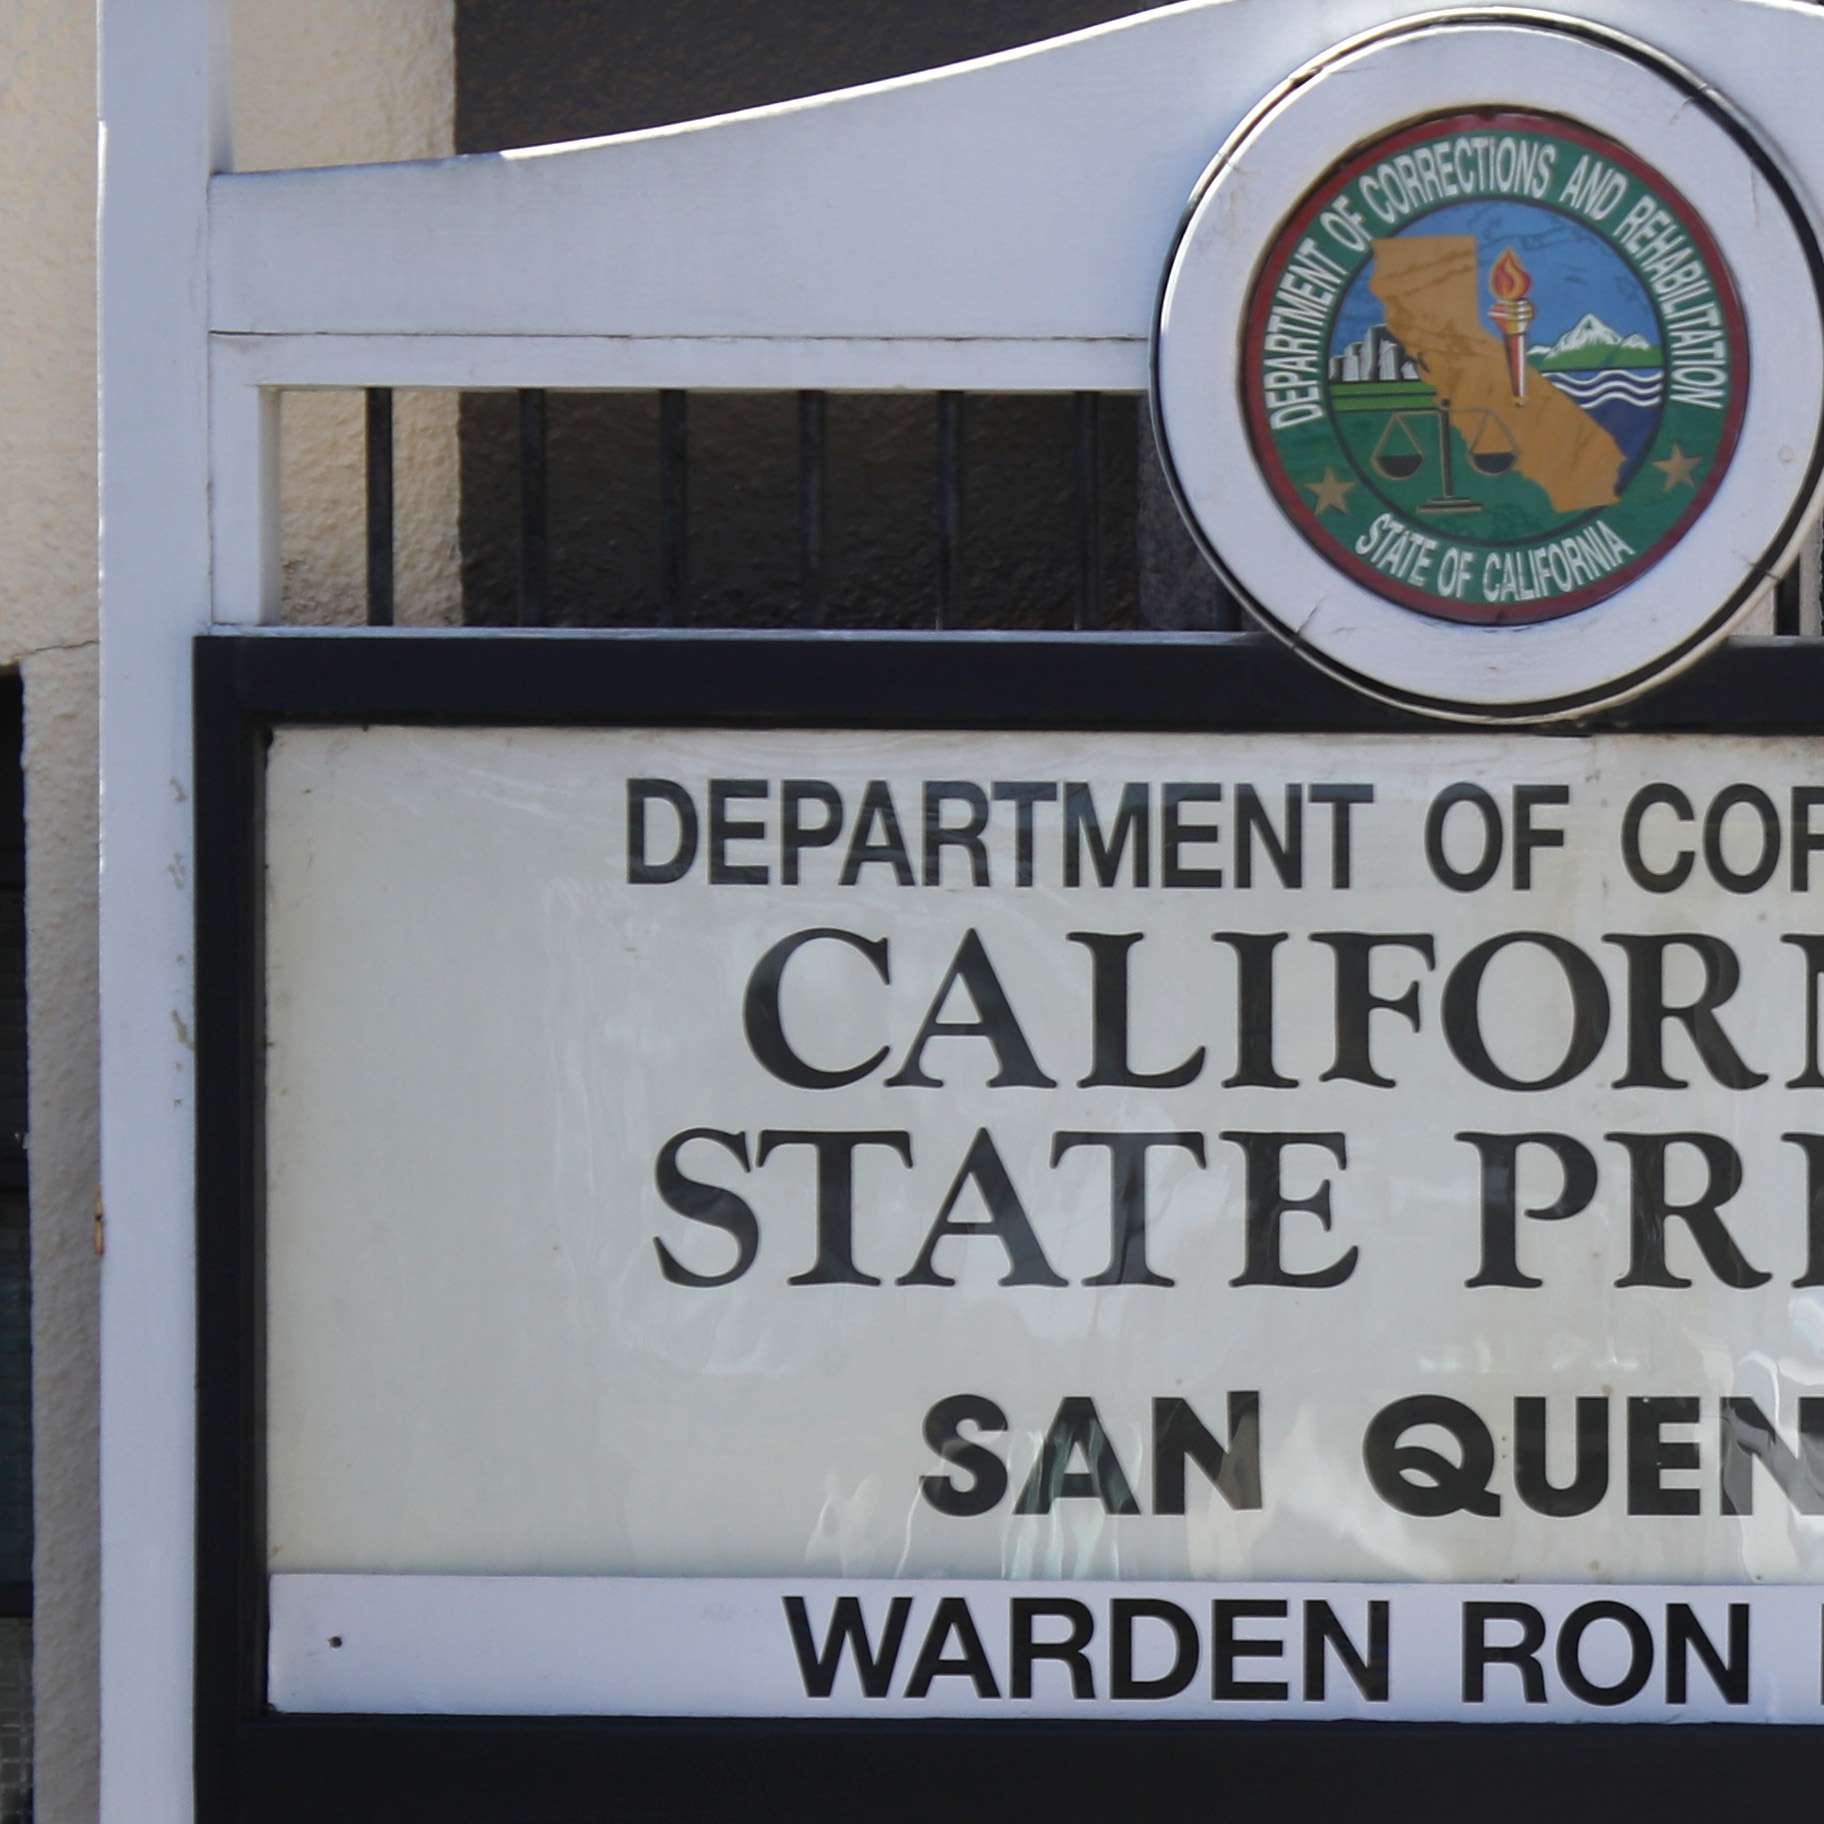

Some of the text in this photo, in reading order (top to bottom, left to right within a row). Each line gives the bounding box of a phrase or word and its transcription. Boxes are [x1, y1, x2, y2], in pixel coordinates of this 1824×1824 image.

[1263, 136, 1728, 429] DEPARTMENT OF CORRECTIONS AND REHABILITATION
[1355, 513, 1636, 602] STATE OF CALIFORNIA
[627, 778, 1374, 889] DEPARTMENT
[1425, 782, 1570, 893] OF
[653, 1127, 1359, 1288] STATE
[919, 1390, 1262, 1517] SAN
[783, 1596, 1389, 1702] WARDEN
[1462, 1600, 1749, 1706] RON
